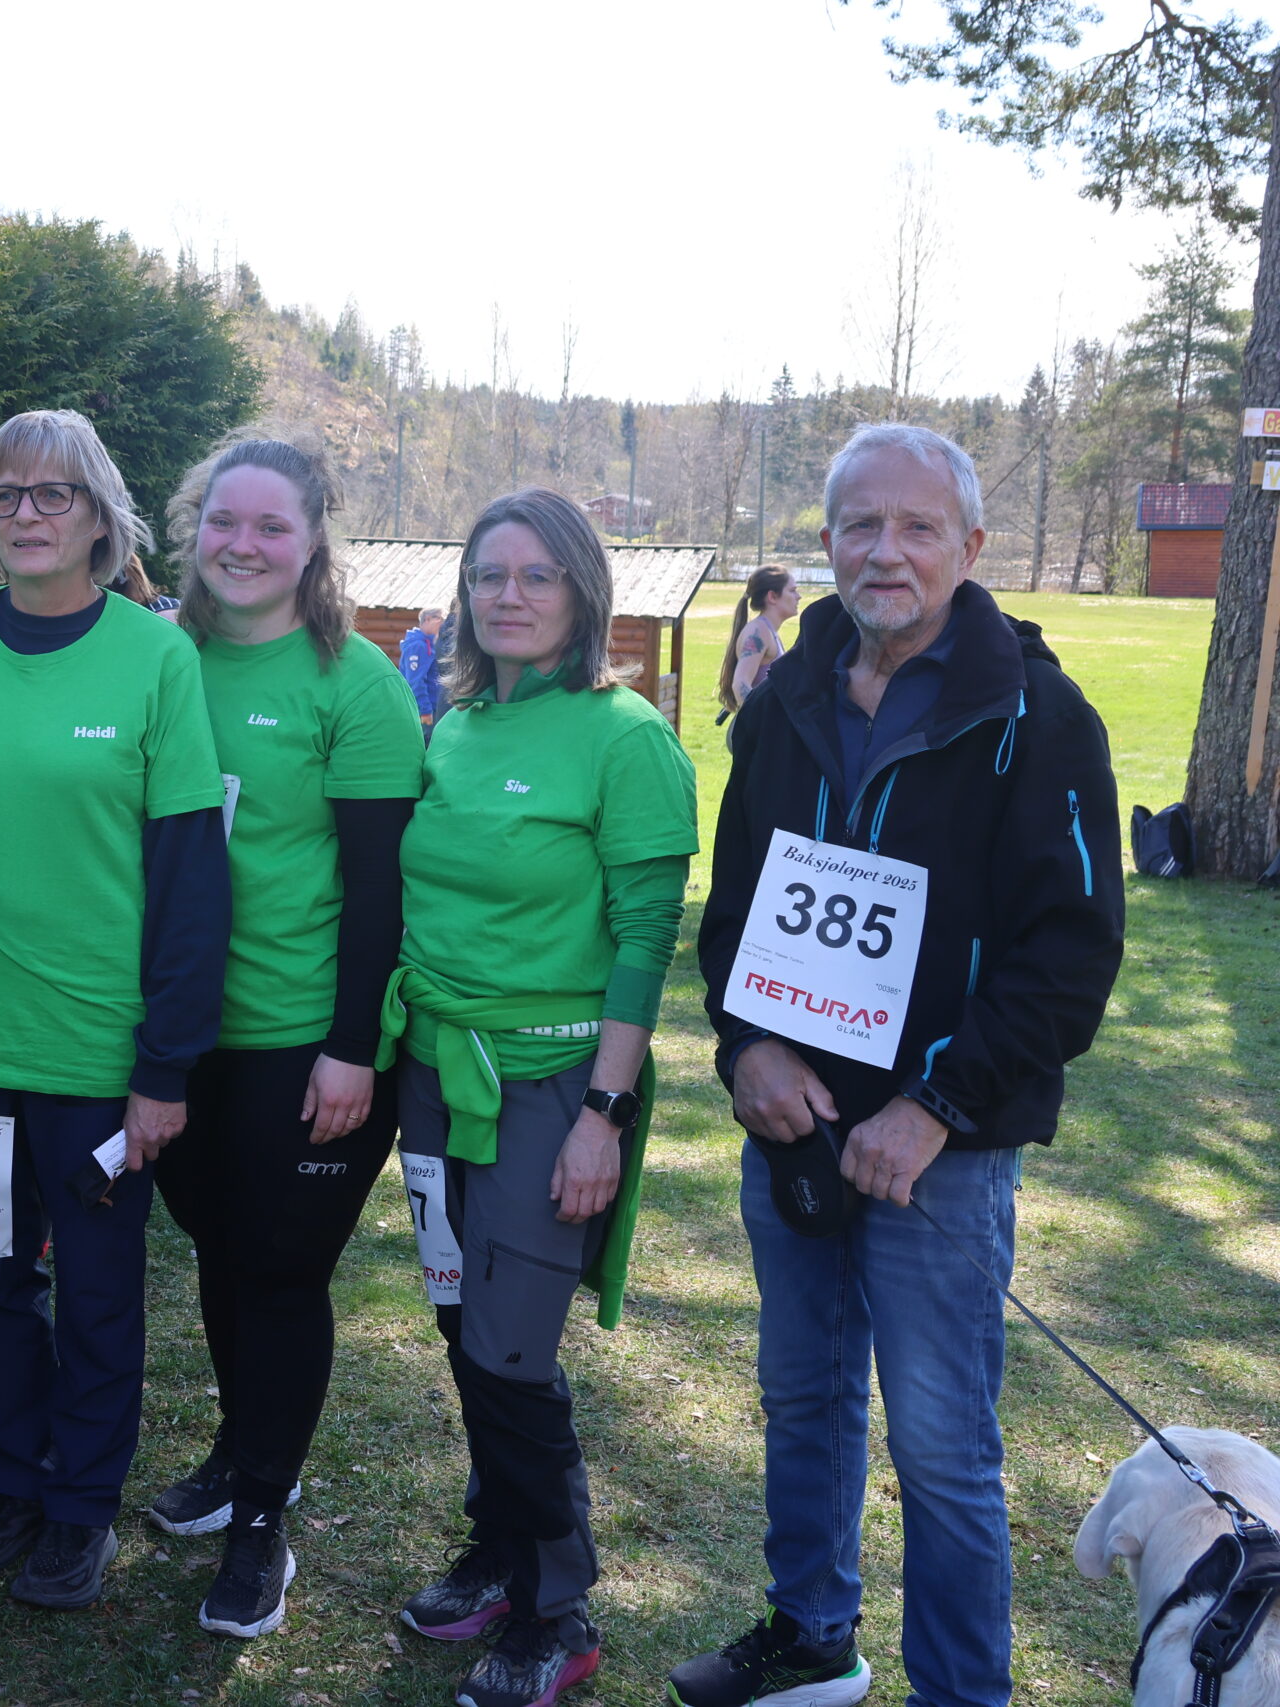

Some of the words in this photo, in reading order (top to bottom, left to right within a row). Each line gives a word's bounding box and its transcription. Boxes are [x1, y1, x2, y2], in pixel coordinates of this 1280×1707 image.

[74, 726, 116, 739] Heidi
[247, 713, 278, 726] Linn
[504, 779, 531, 794] Siw
[781, 845, 880, 882] Baksjøløpet
[881, 873, 919, 892] 2025
[775, 882, 897, 959] 385
[744, 972, 872, 1029] RETURA
[410, 1165, 436, 1179] 2025
[410, 1188, 427, 1232] 7
